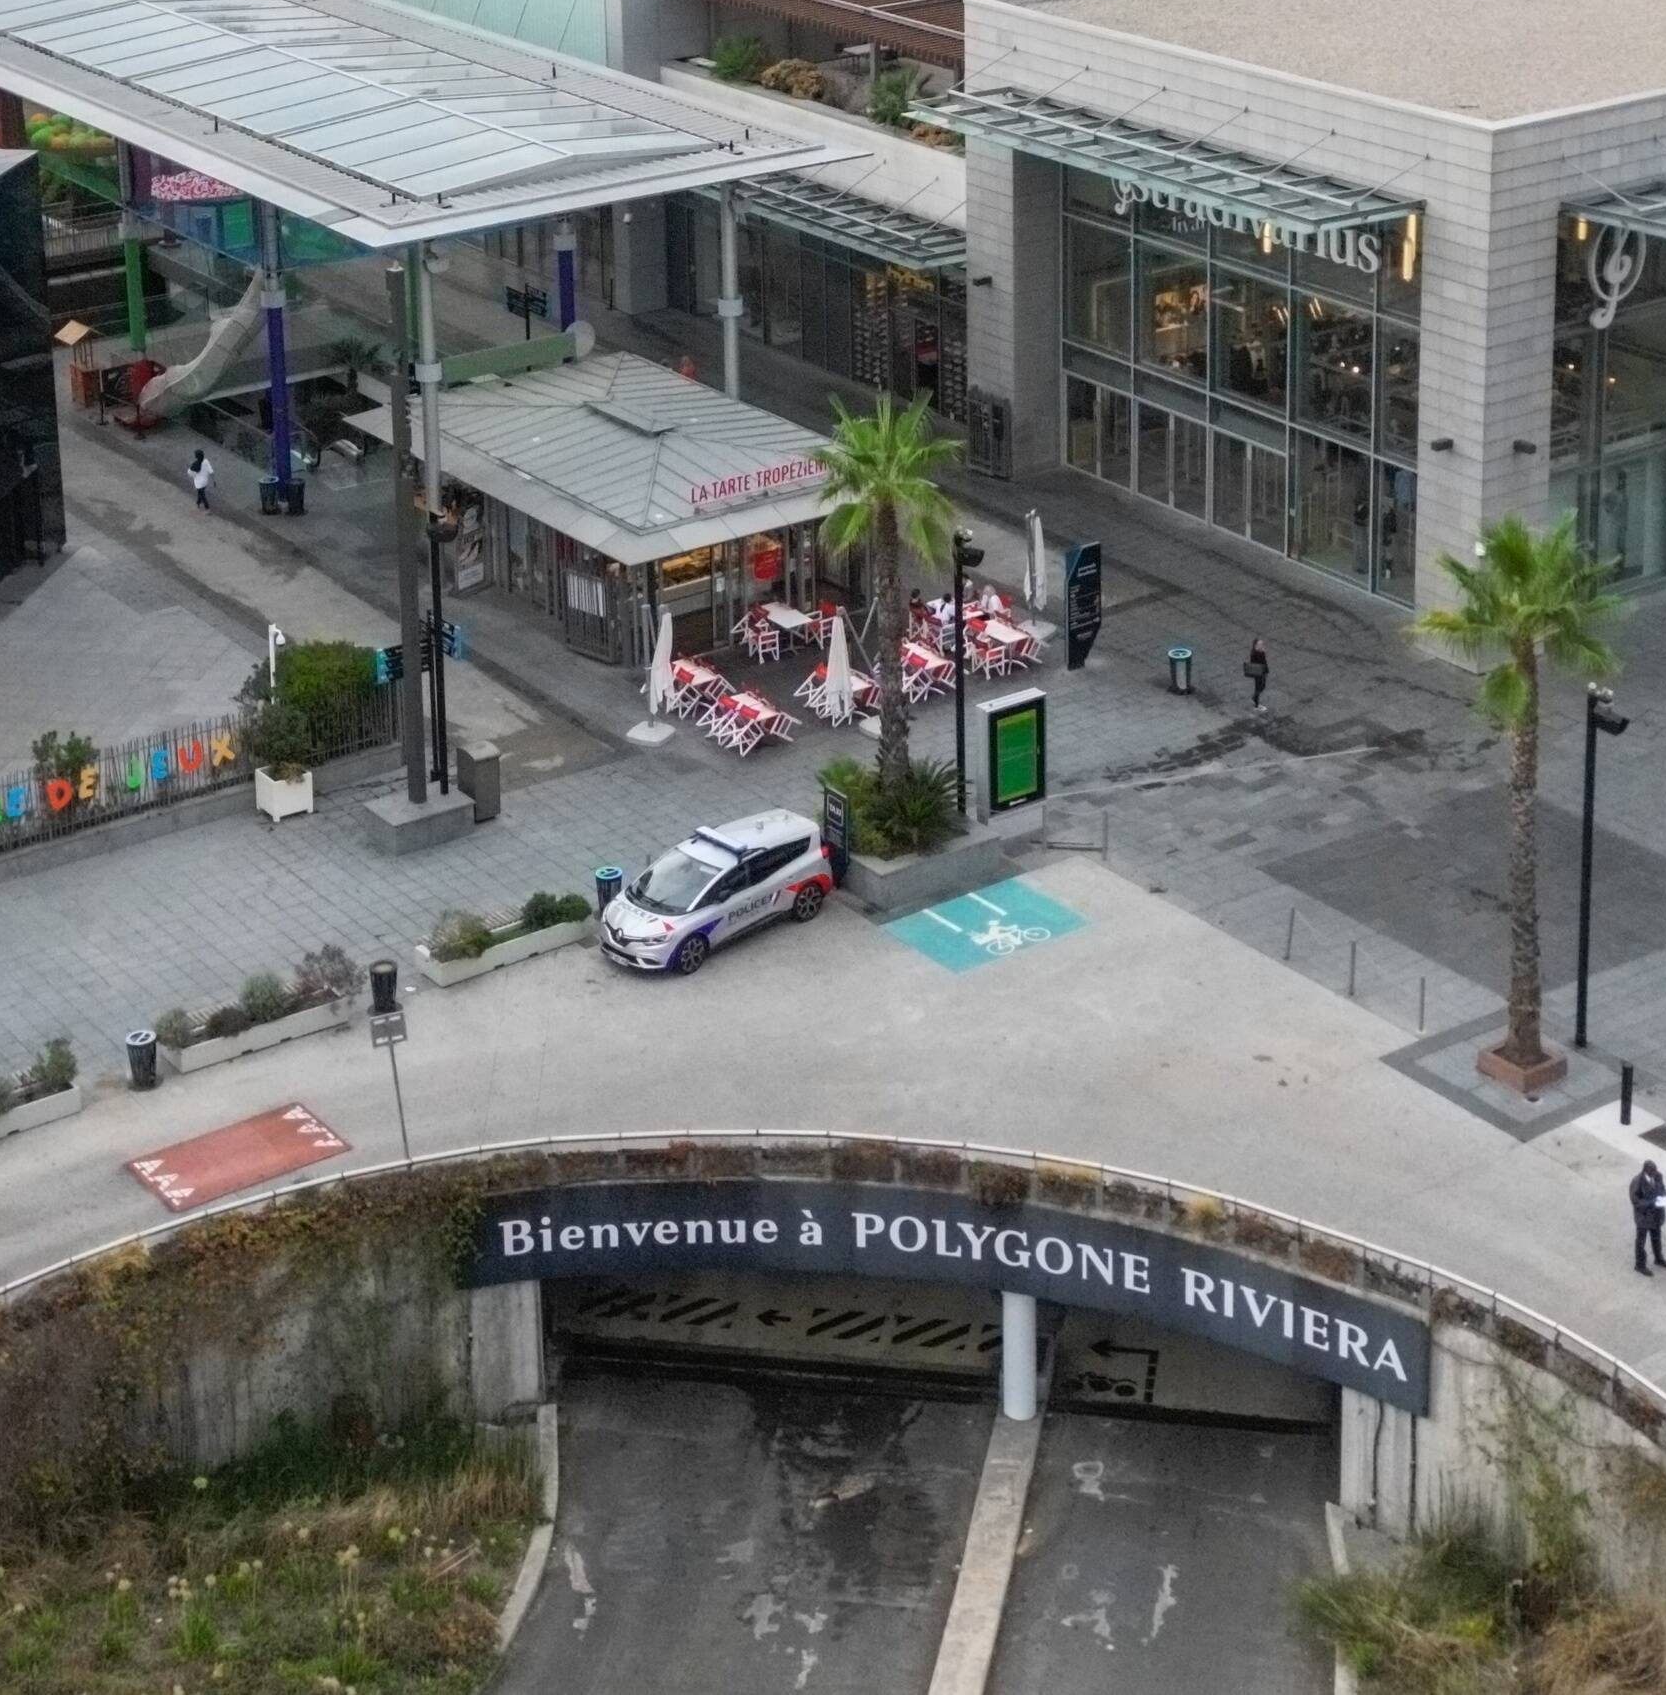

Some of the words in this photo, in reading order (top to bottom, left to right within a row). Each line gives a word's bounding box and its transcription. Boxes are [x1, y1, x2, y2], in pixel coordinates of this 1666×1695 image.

[691, 485, 708, 504] LA
[712, 474, 751, 499] TARTE
[46, 767, 98, 812] DE
[126, 734, 235, 790] JEUX
[498, 1216, 778, 1257] Bienvenue
[799, 1209, 823, 1246] à
[851, 1210, 1150, 1294] POLYGONE
[1181, 1266, 1409, 1383] RIVIERA
